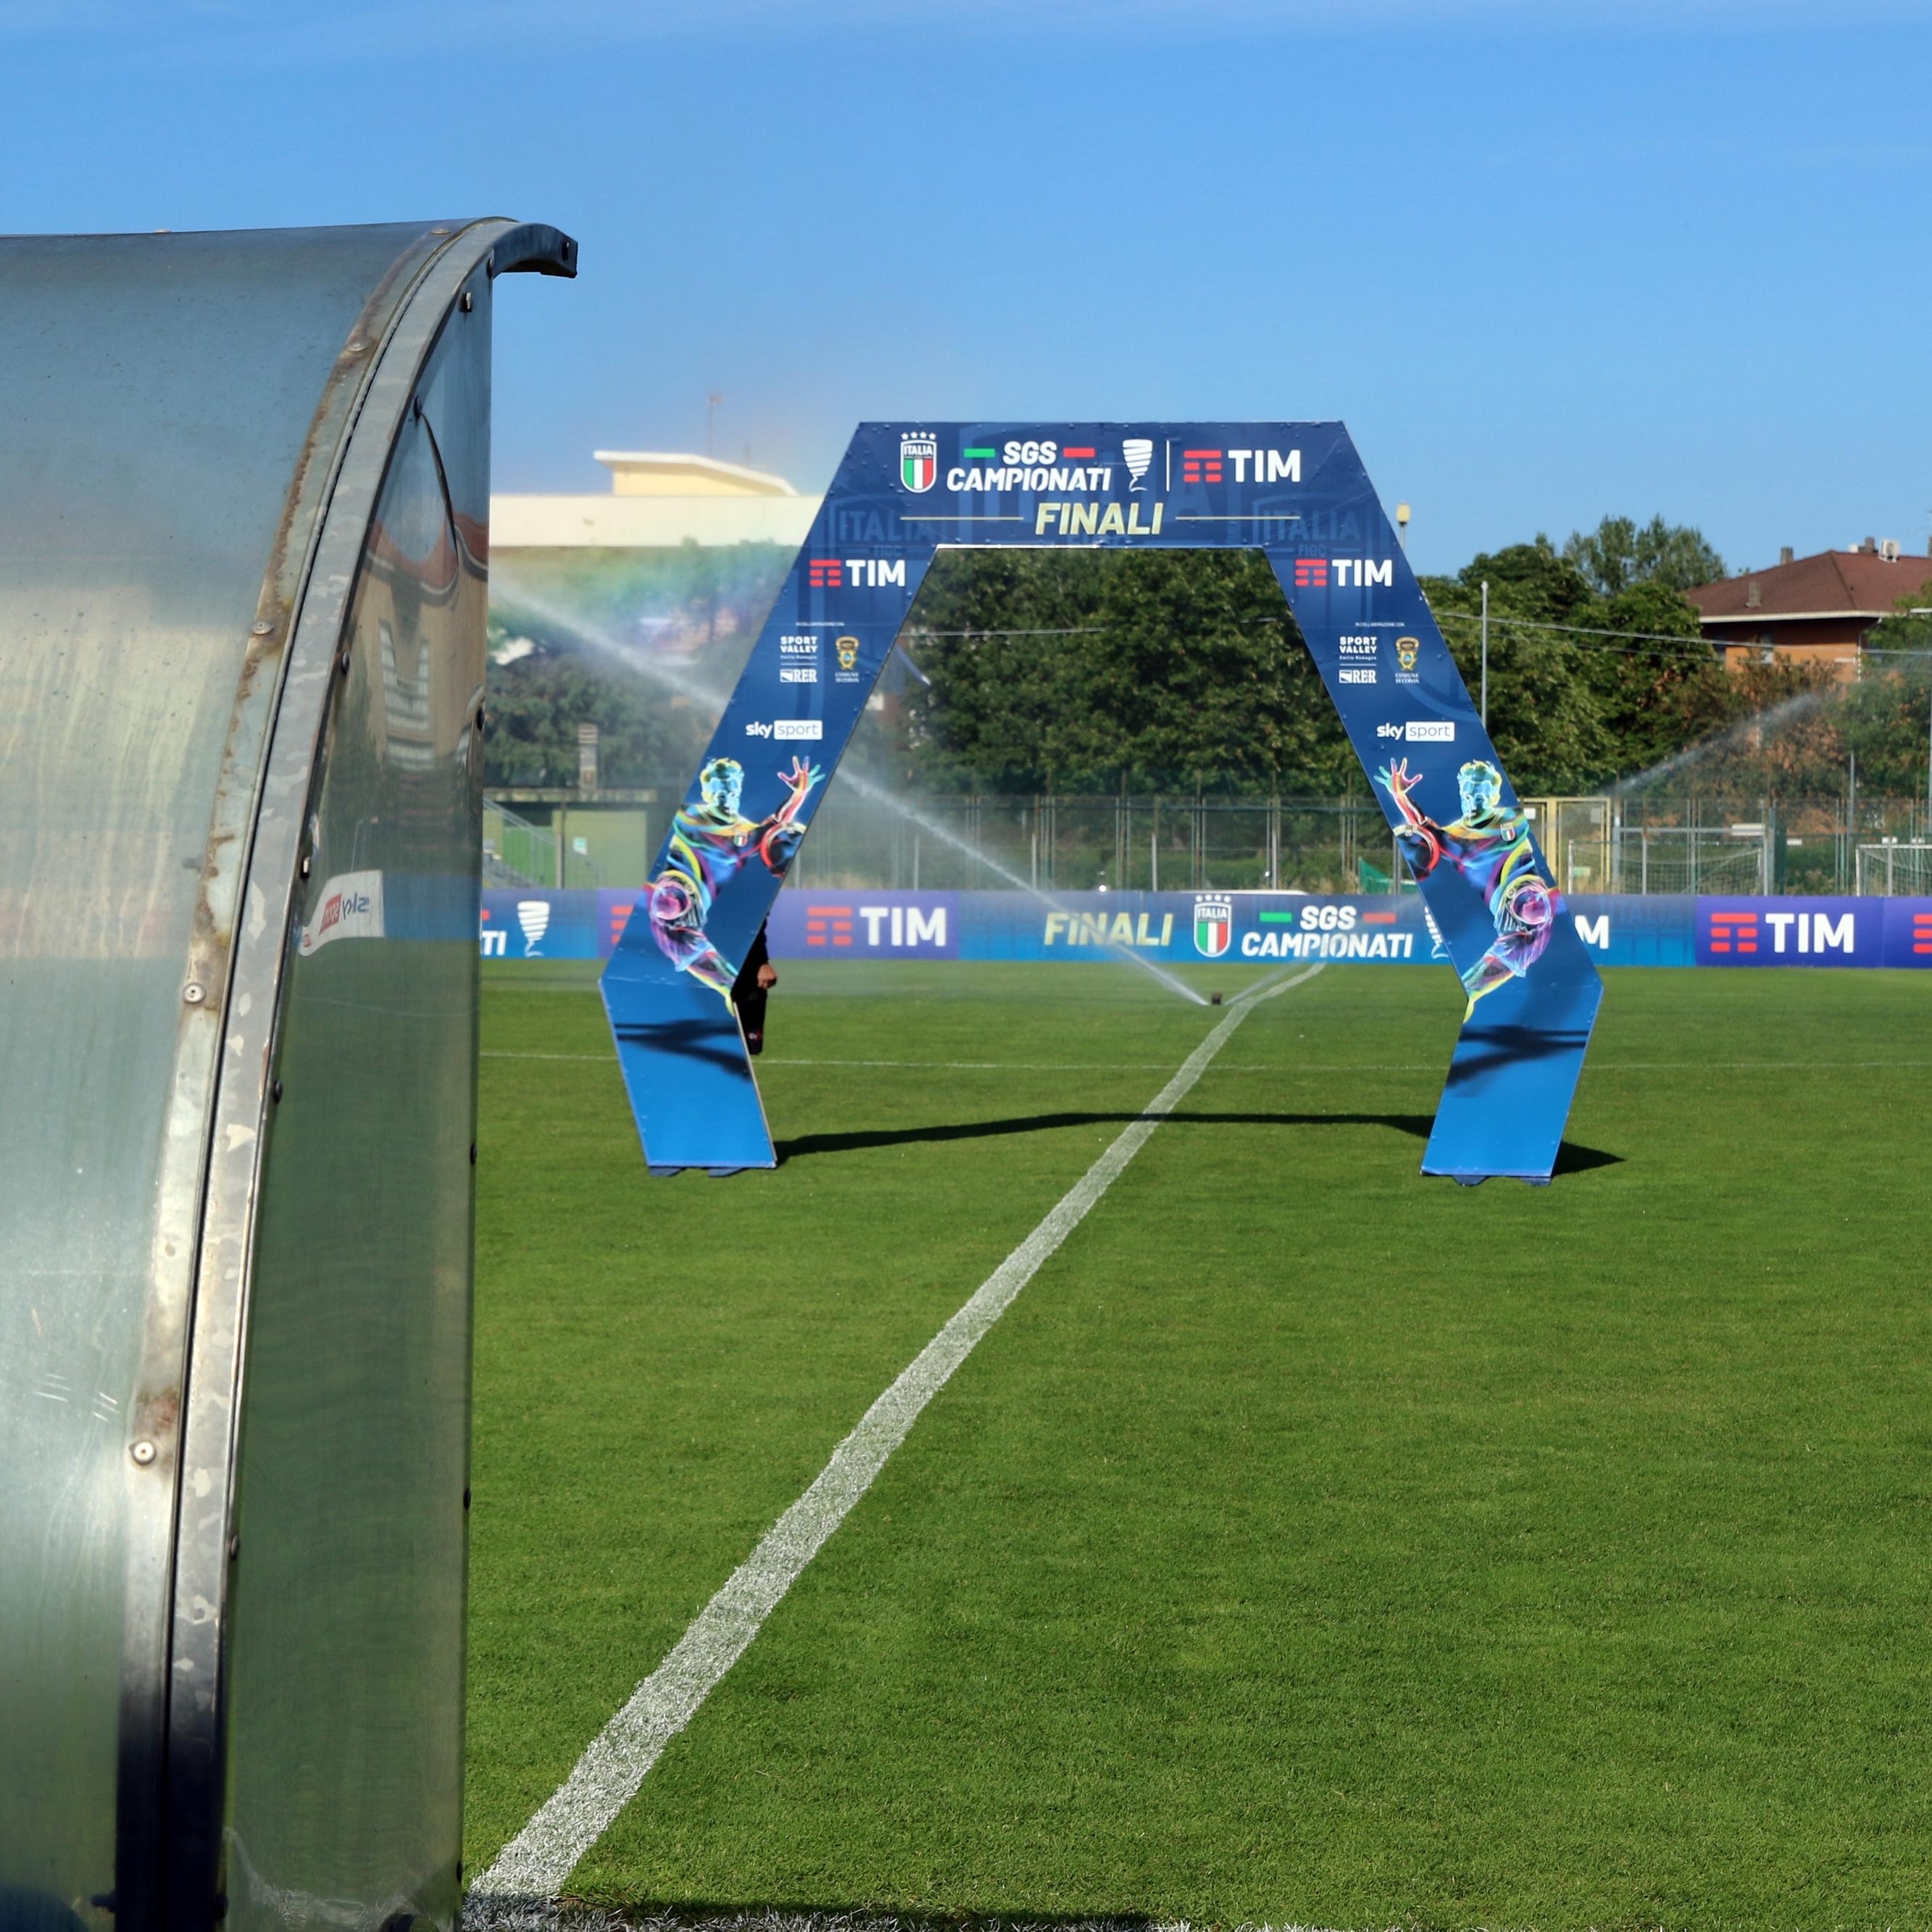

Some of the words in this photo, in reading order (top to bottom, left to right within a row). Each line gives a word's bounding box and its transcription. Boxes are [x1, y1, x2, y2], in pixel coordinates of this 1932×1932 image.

[904, 444, 933, 456] ITALIA
[1002, 441, 1057, 465] SGS
[1228, 449, 1301, 483] TIM
[946, 467, 1112, 491] CAMPIONATI
[1035, 502, 1164, 535] FINALI
[845, 559, 905, 587] TIM
[1331, 559, 1392, 587] TIM
[780, 636, 818, 645] SPORT
[1339, 636, 1378, 646] SPORT
[794, 668, 817, 683] RER
[1353, 669, 1377, 683] RER
[746, 721, 773, 738] sky
[778, 725, 819, 737] sport
[1376, 723, 1404, 741] sky
[1409, 725, 1451, 738] sport
[1198, 907, 1228, 919] ITALIA
[1299, 905, 1357, 930] SGS
[859, 906, 946, 946] TIM
[1044, 913, 1173, 945] FINALI
[1765, 913, 1854, 953] TIM
[1241, 931, 1413, 958] CAMPIONATI
